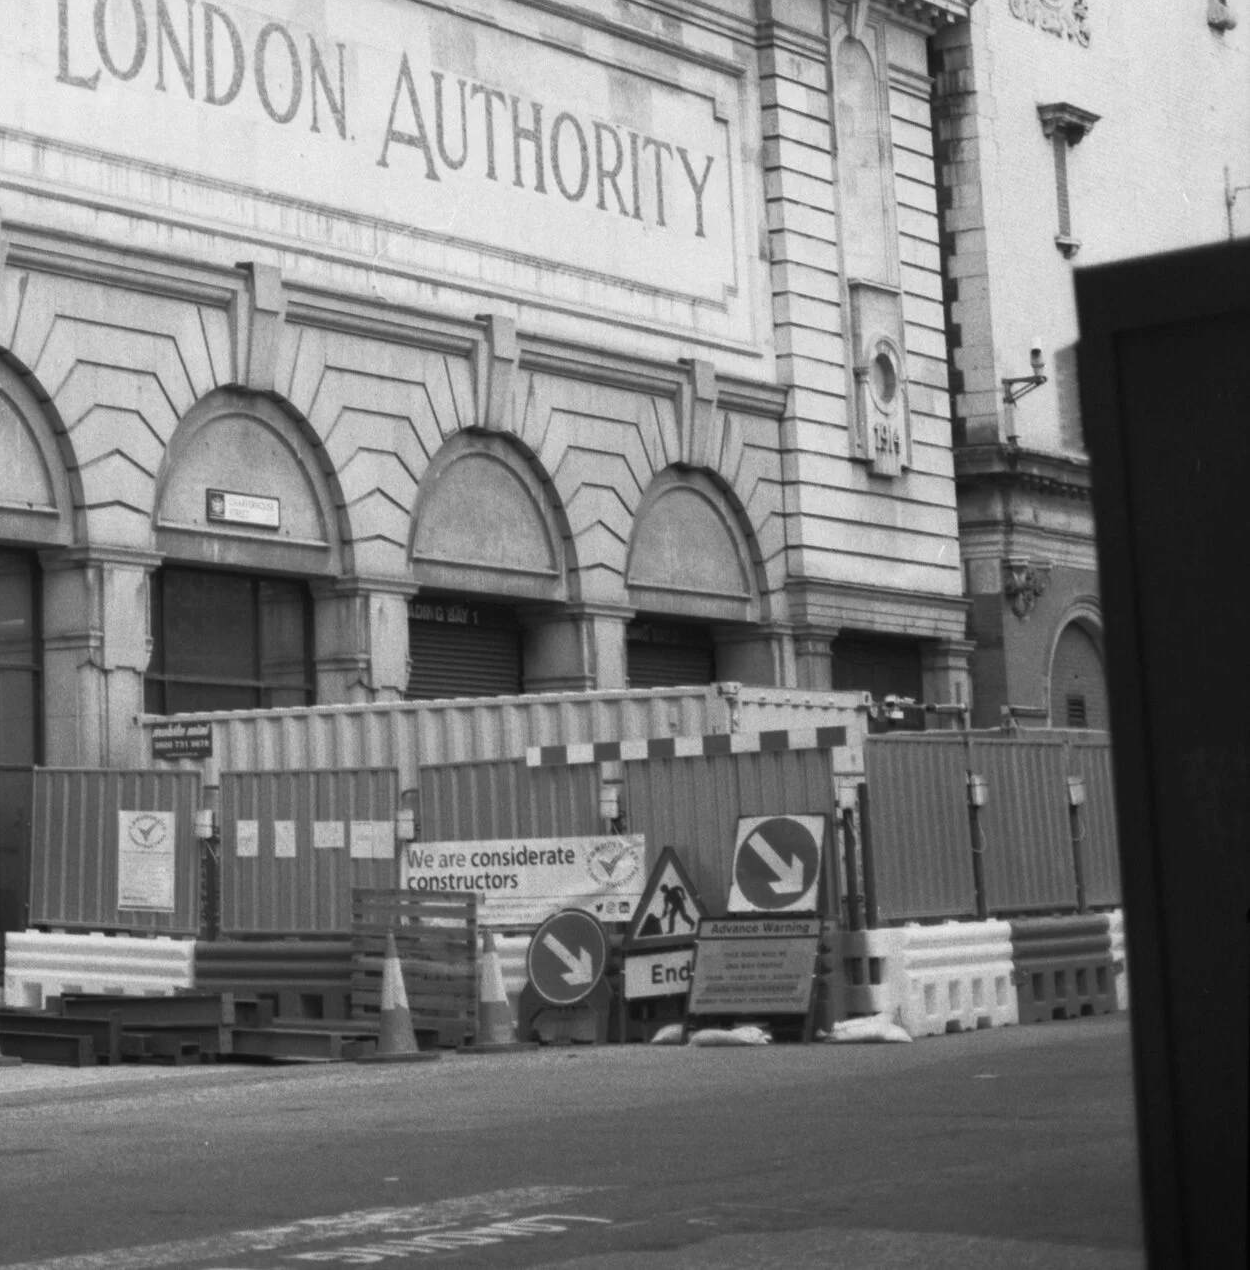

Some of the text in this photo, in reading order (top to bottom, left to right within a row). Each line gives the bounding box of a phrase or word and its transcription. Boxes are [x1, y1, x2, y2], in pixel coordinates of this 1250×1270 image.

[377, 50, 715, 238] AUTHORITY
[407, 845, 576, 868] We are considerate
[408, 873, 519, 891] constructors
[711, 921, 811, 935] Advance Warning
[651, 960, 691, 985] End
